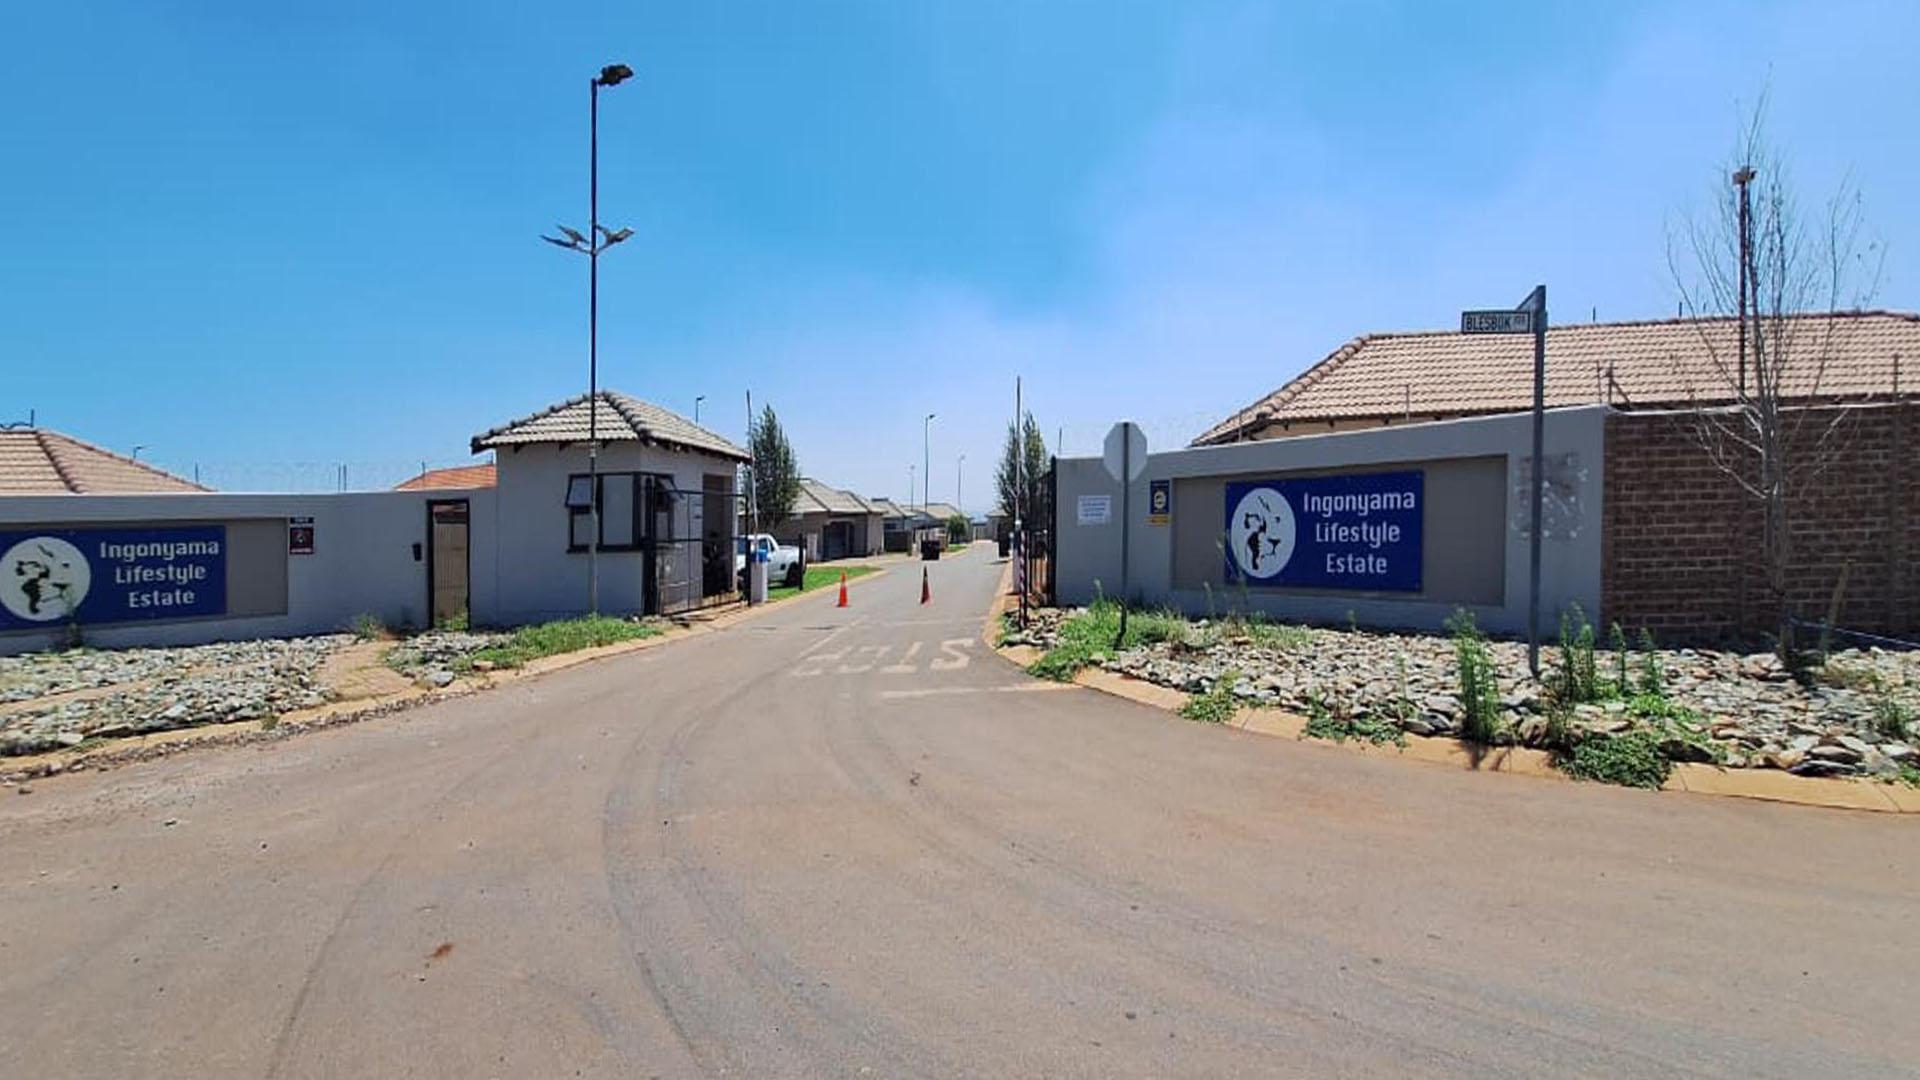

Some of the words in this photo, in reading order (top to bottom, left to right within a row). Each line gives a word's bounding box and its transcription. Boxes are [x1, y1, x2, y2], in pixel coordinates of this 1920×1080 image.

[1303, 491, 1416, 518] Ingonyama
[1316, 522, 1400, 548] Lifestyle
[100, 540, 219, 562] Ingonyama
[116, 563, 206, 585] Lifestyle
[1327, 553, 1387, 574] Estate
[129, 589, 195, 608] Estate
